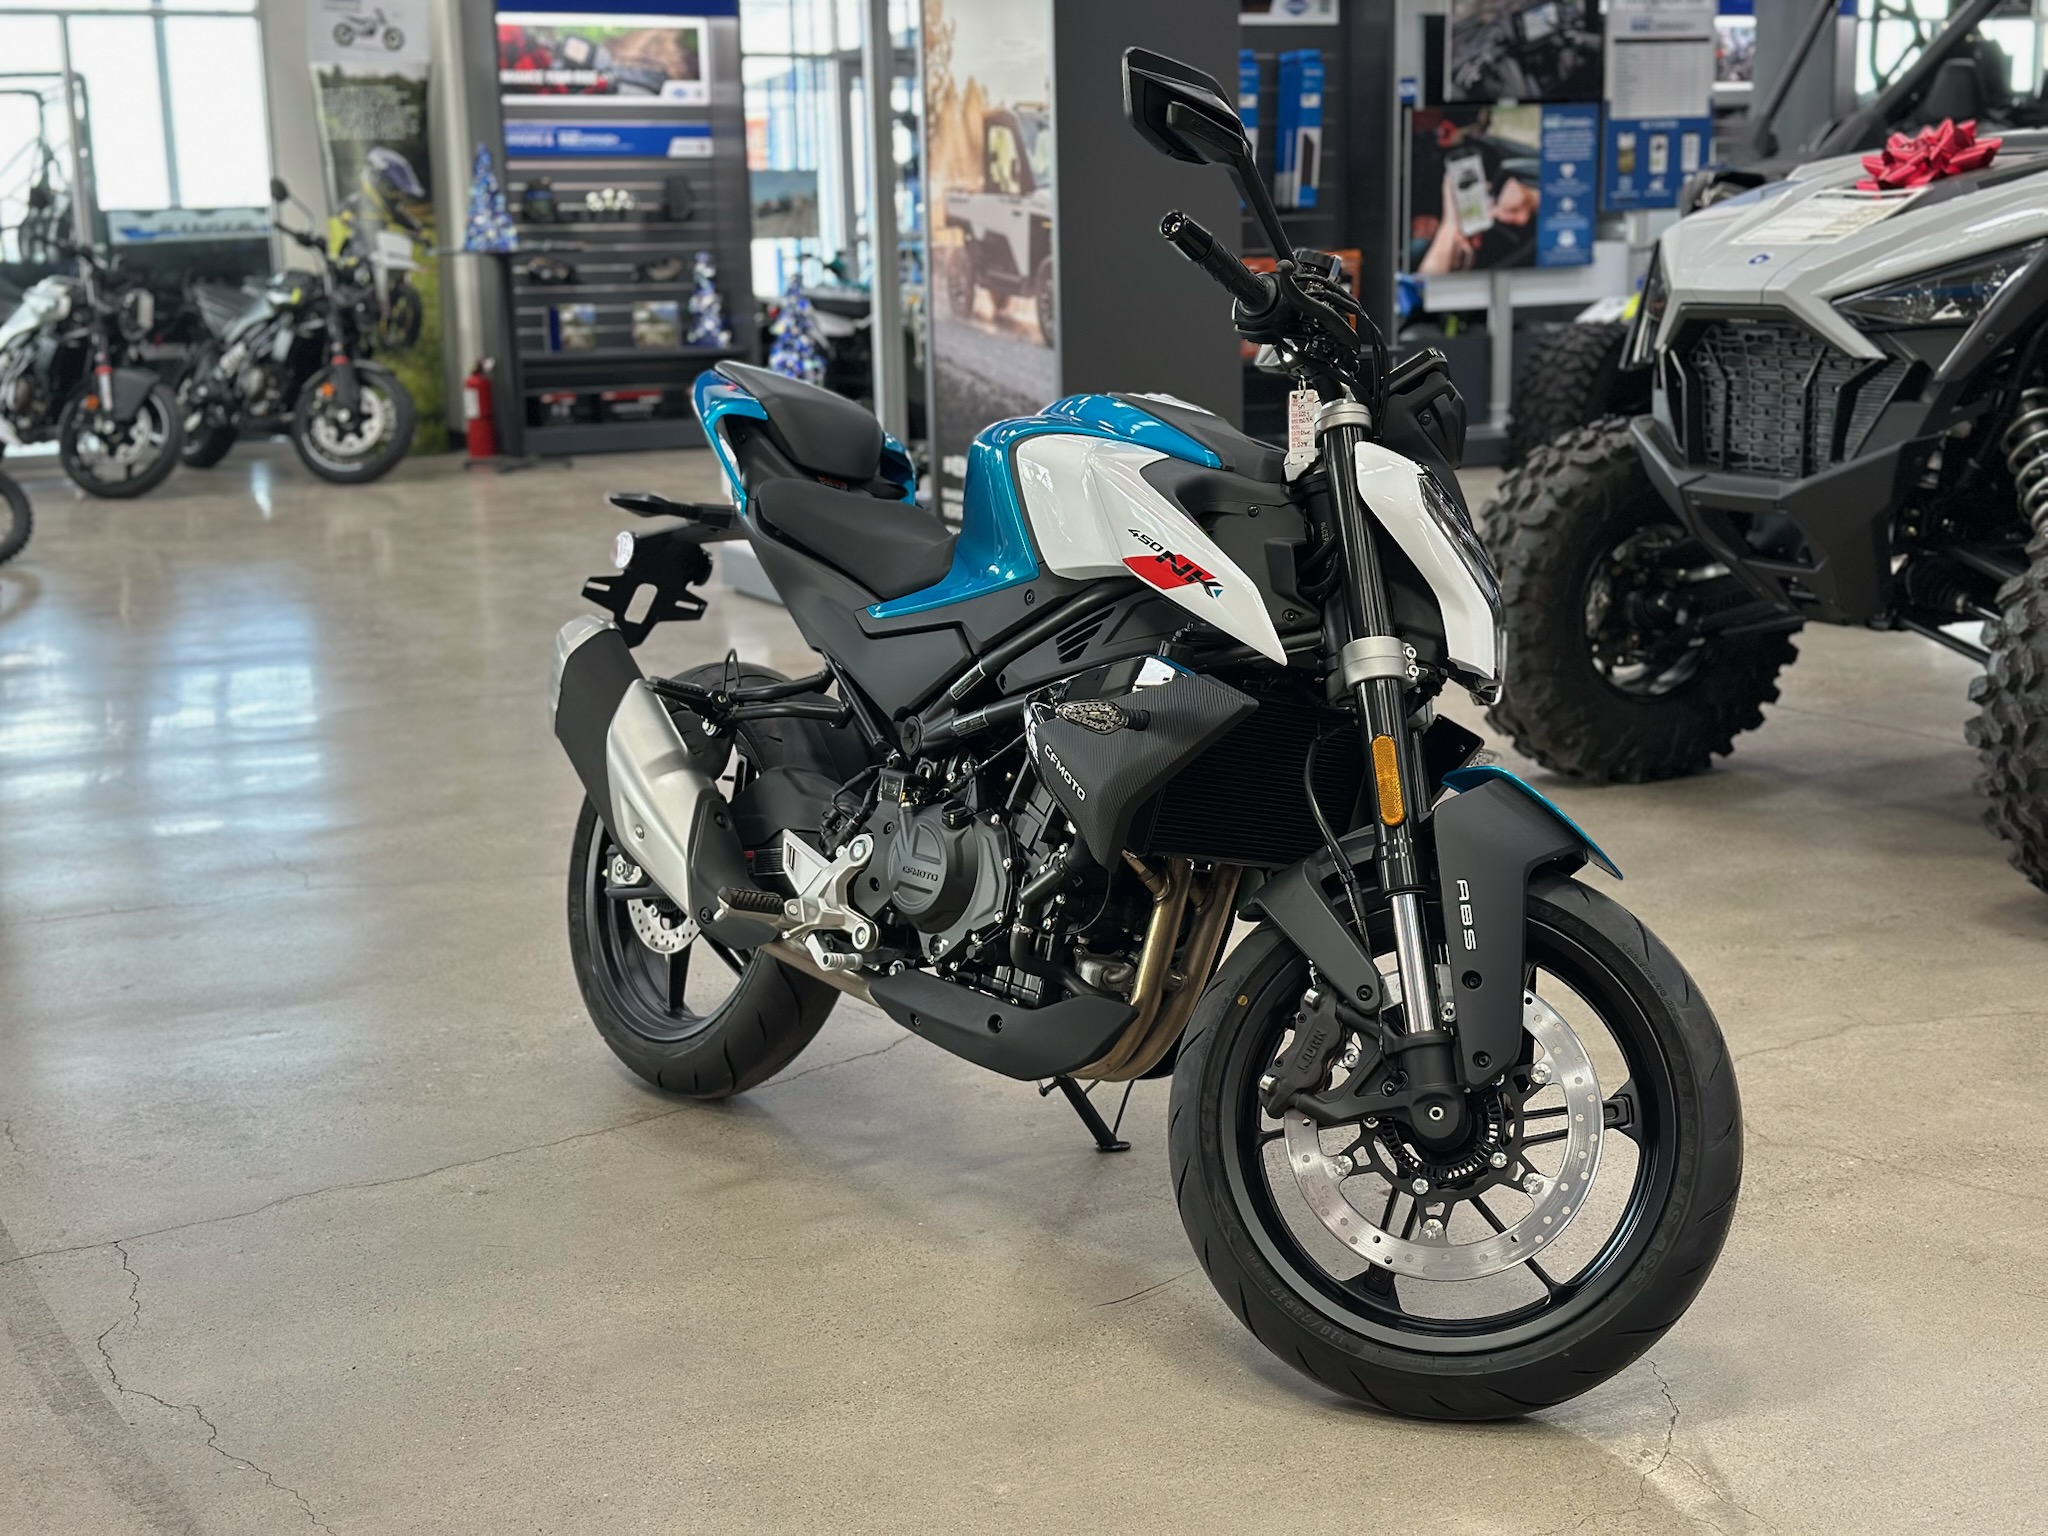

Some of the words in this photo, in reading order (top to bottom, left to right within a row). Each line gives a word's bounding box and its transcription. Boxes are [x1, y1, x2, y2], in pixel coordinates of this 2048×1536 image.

[1044, 743, 1086, 801] CFMOTO
[902, 865, 939, 882] CFMOTO
[1456, 879, 1477, 951] ABS
